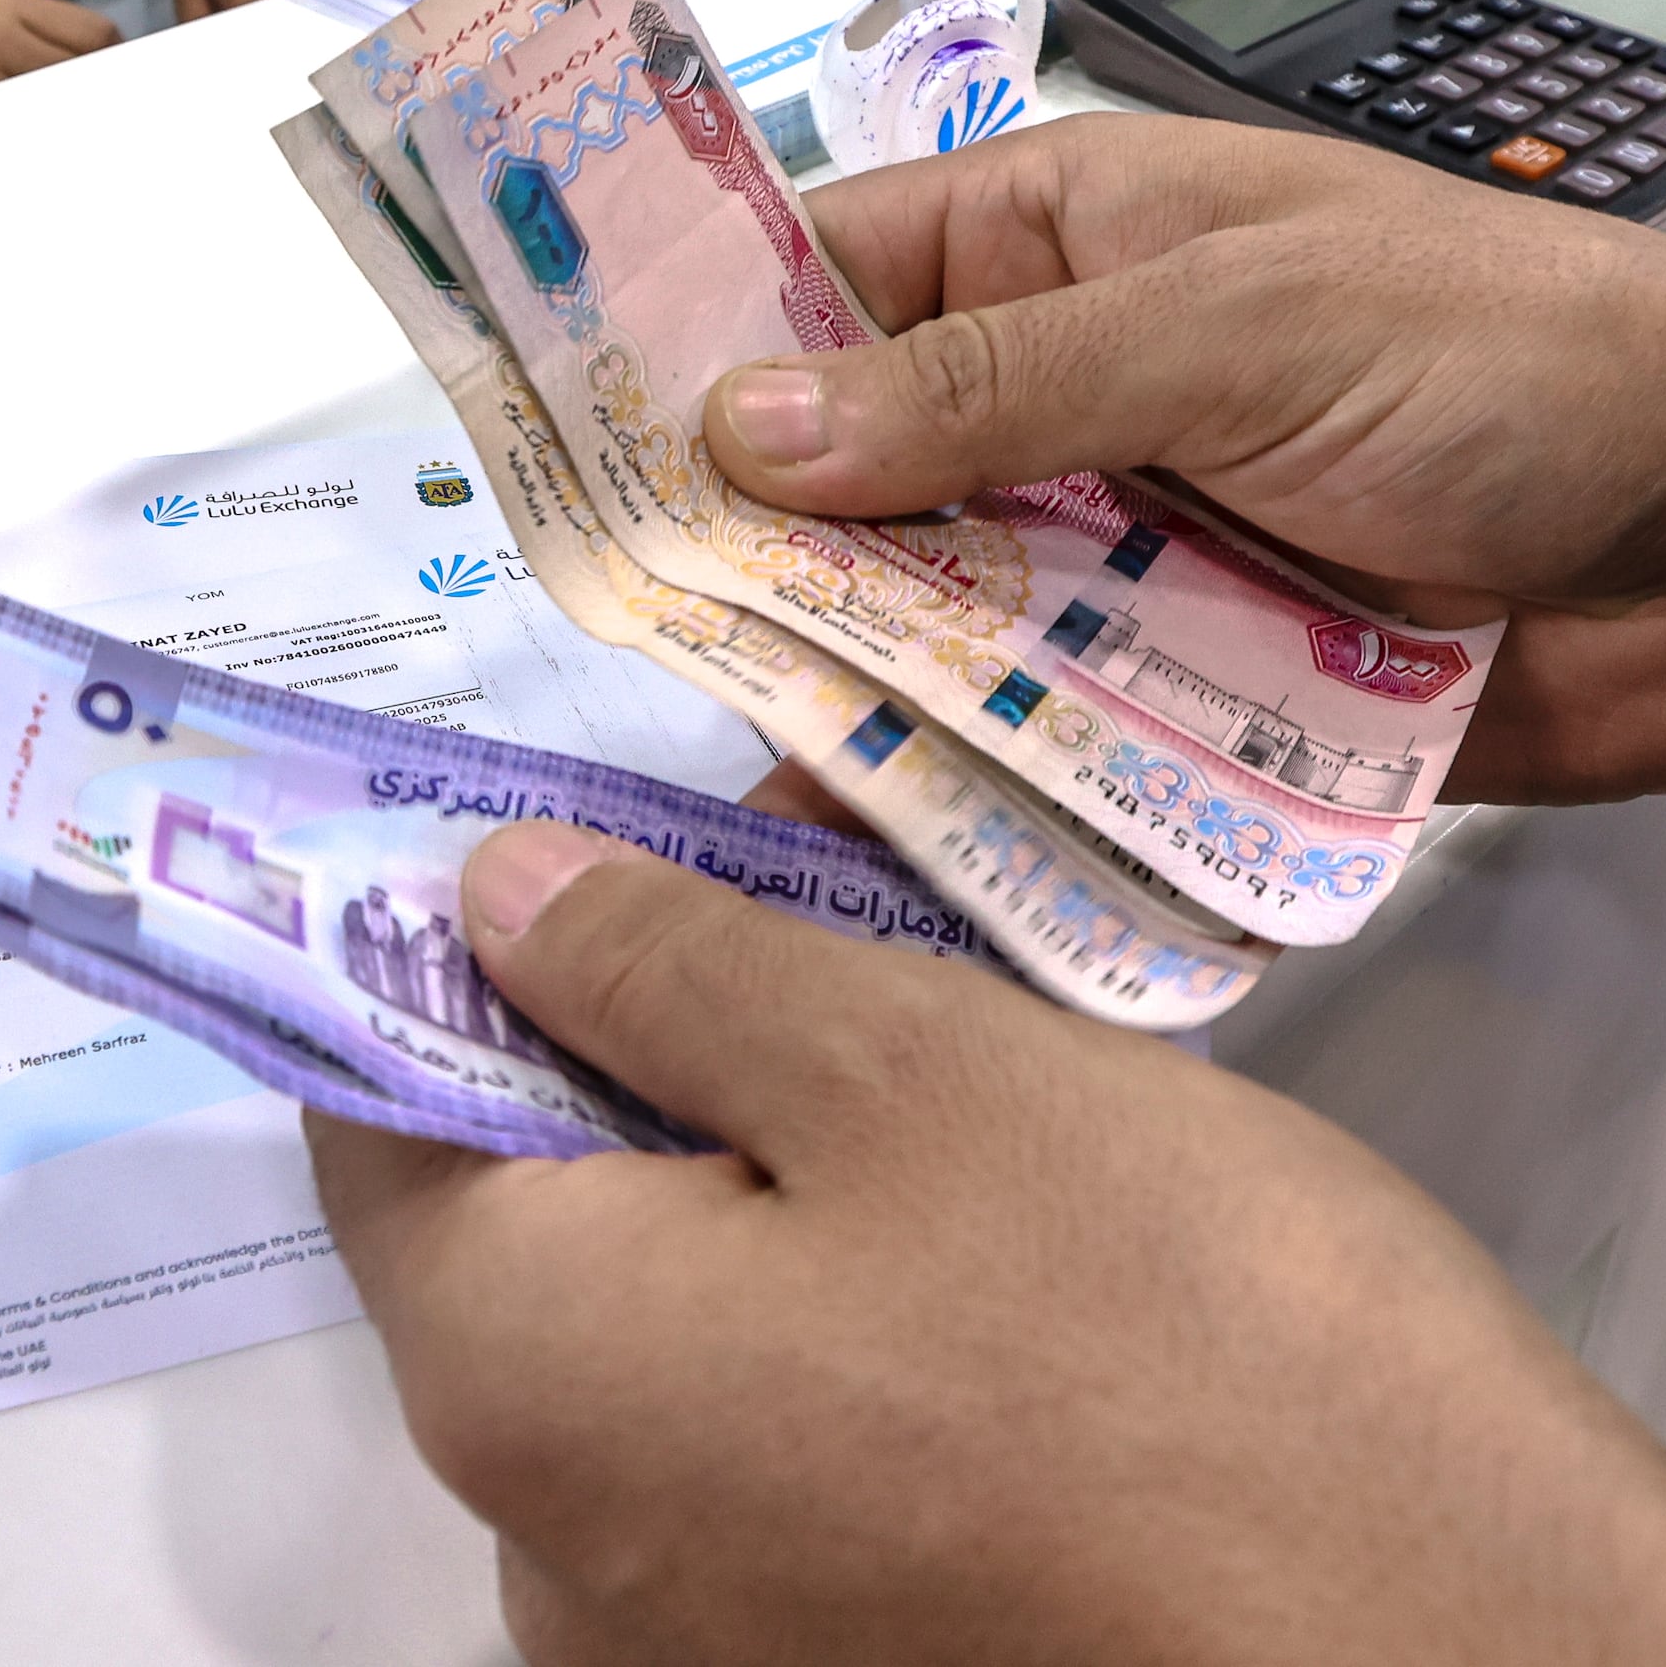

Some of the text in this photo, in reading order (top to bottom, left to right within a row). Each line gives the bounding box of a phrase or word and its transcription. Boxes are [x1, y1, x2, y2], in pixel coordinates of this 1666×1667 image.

[1430, 73, 1462, 94] 7
[261, 493, 359, 516] Exchange
[185, 590, 225, 603] YOM
[184, 623, 247, 641] ZAYED
[290, 636, 313, 647] VAT
[225, 659, 249, 671] Inv
[1073, 765, 1297, 910] 298759097
[19, 1044, 87, 1071] Mehreen
[91, 1031, 148, 1054] Sarfraz
[35, 1296, 46, 1308] &
[49, 1275, 132, 1303] Conditions
[134, 1265, 166, 1282] and
[167, 1241, 267, 1274] acknowledge
[270, 1233, 295, 1248] the
[17, 1340, 47, 1357] UAE
